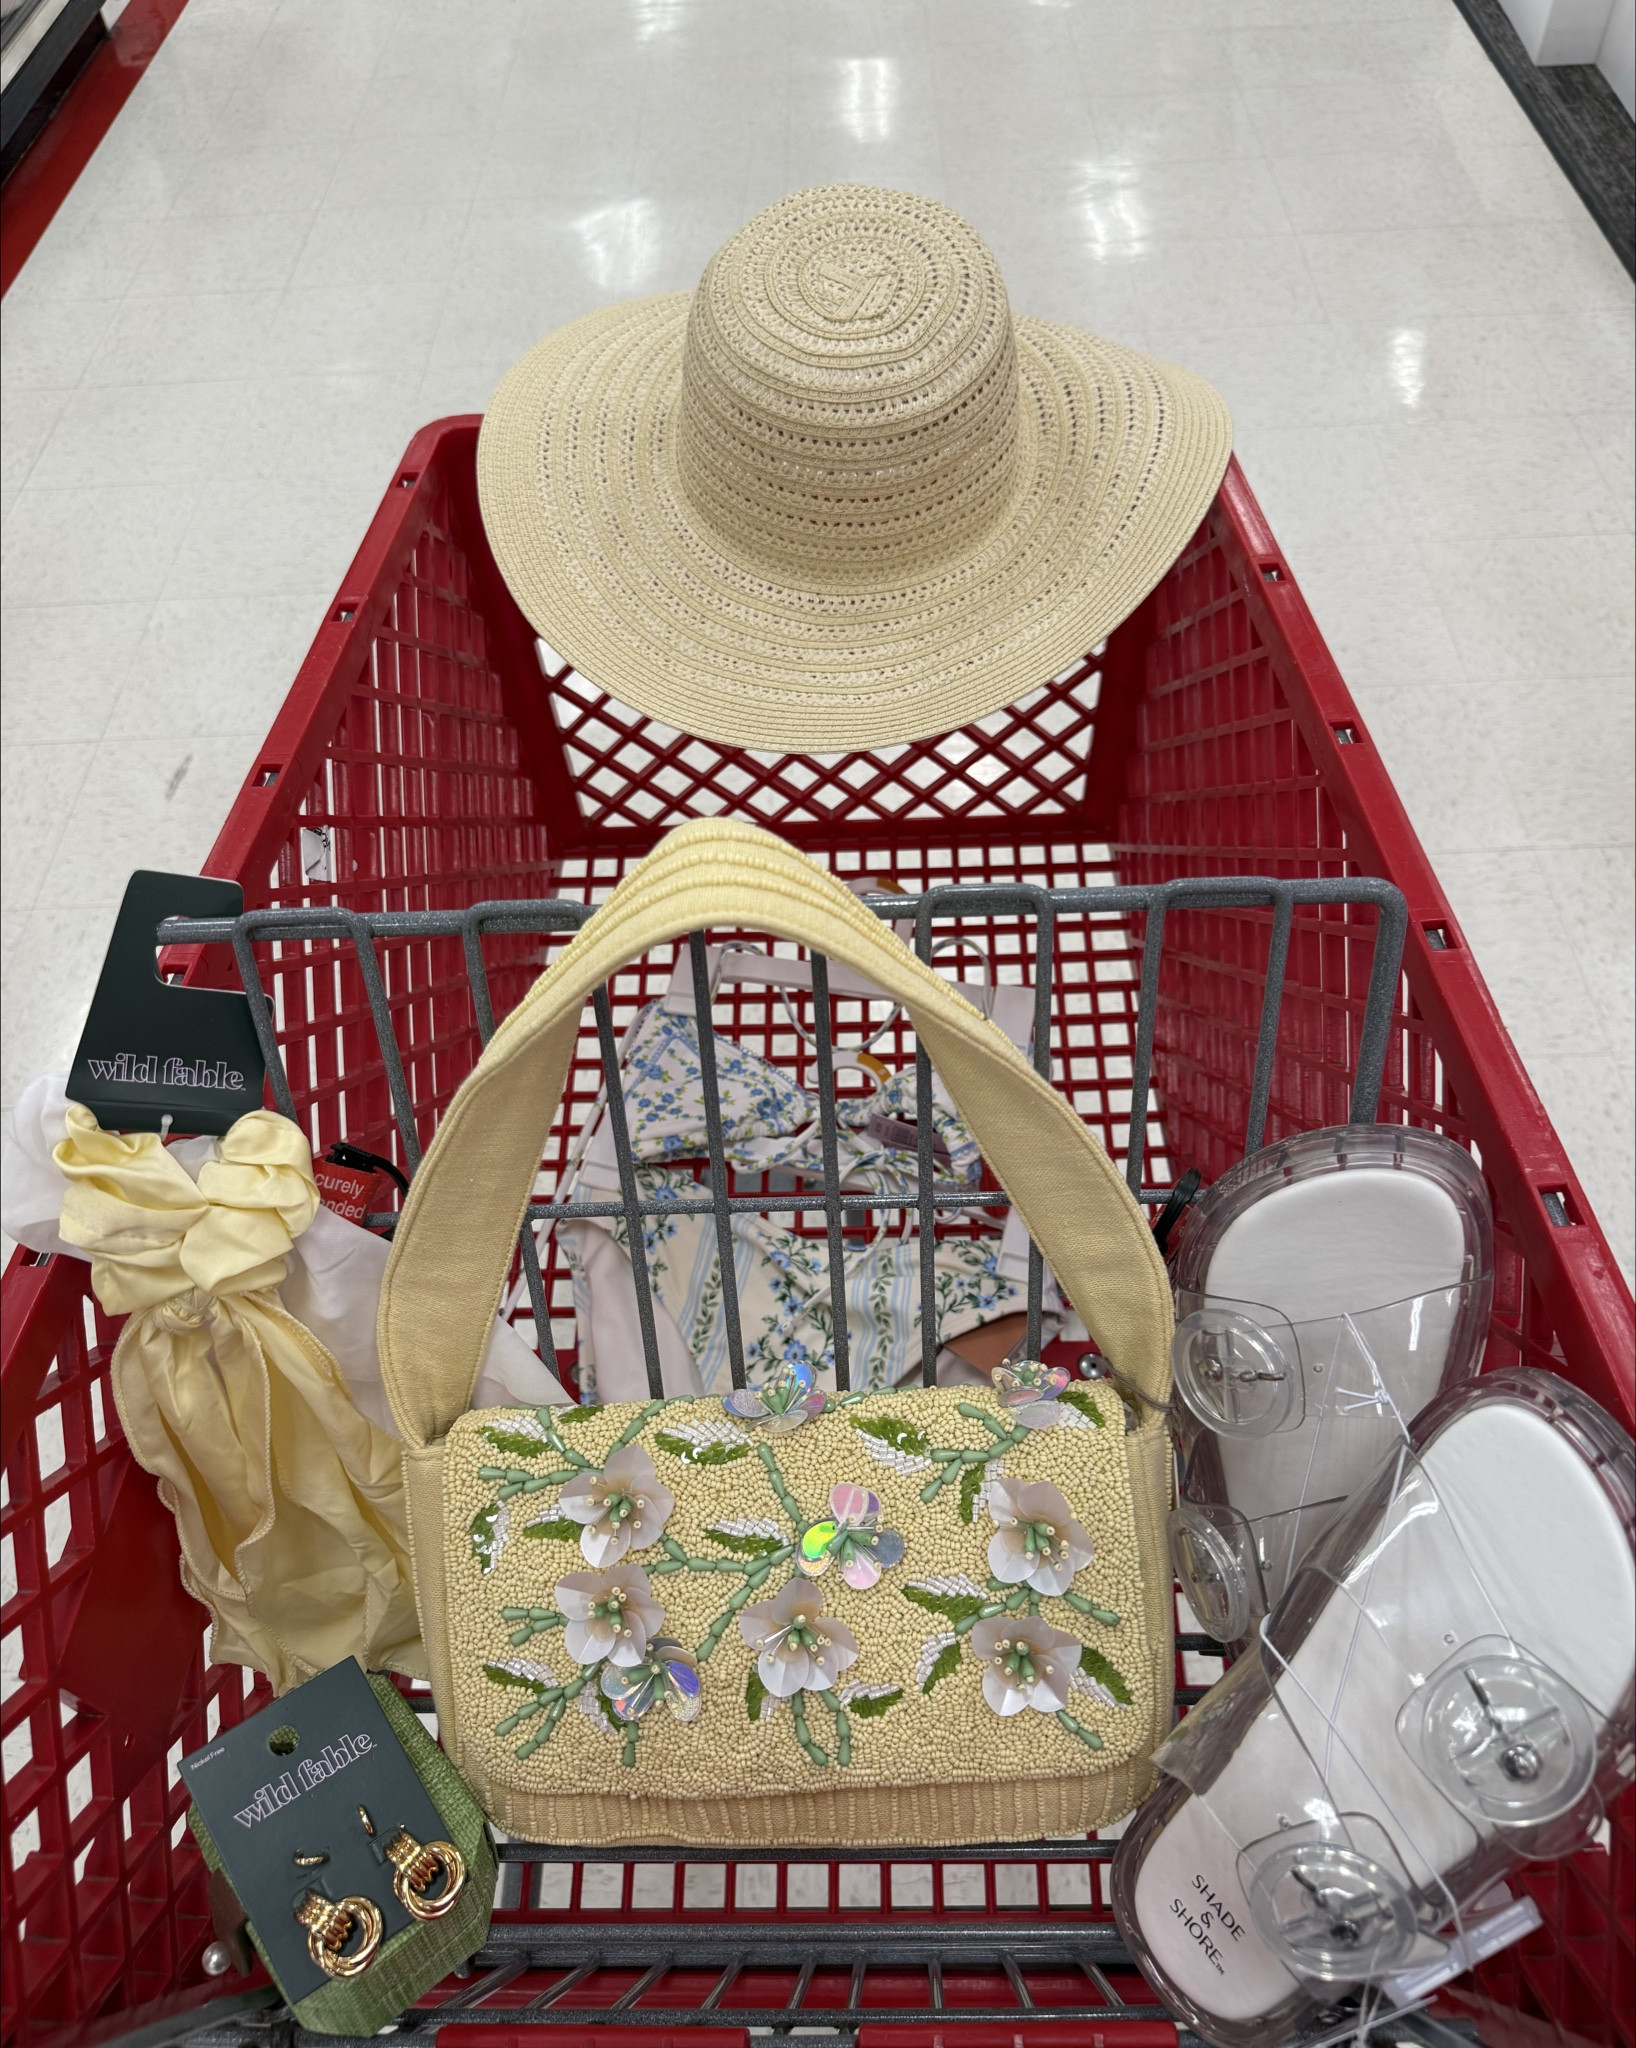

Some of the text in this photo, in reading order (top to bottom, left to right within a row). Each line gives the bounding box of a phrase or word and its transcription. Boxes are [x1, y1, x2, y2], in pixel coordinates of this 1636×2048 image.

[87, 1052, 245, 1090] wild fable
[320, 1198, 367, 1219] nded
[190, 1747, 225, 1770] Nickel Free
[233, 1733, 373, 1829] wild fable
[1191, 1874, 1246, 1942] SHADE
[1200, 1911, 1214, 1929] &
